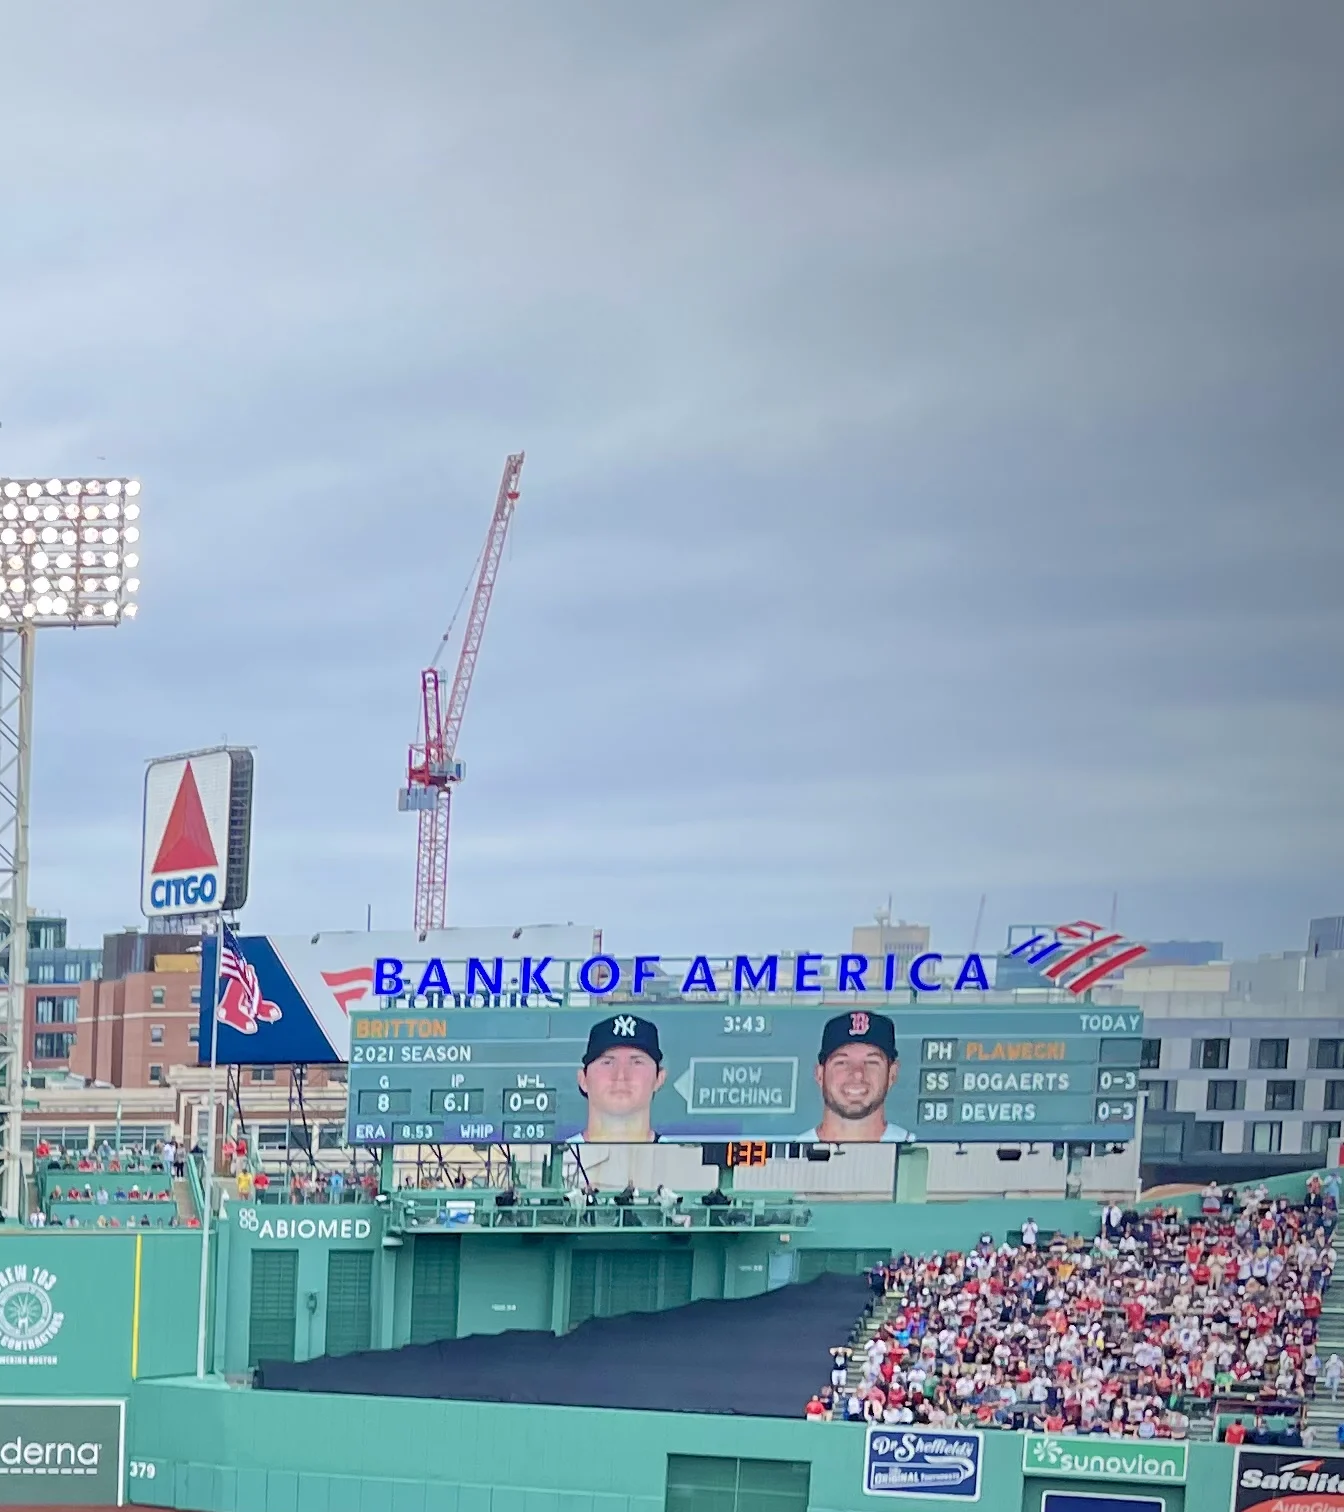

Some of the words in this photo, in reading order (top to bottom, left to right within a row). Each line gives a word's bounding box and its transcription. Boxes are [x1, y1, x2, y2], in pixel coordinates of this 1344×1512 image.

[151, 873, 217, 909] CITGO
[372, 956, 555, 998] BANK
[578, 954, 661, 996] OF
[681, 952, 990, 995] AMERICA
[356, 1019, 447, 1039] BRITTON
[723, 1016, 765, 1033] 3:43
[1080, 1015, 1141, 1031] TODAY
[353, 1046, 394, 1062] 2021
[401, 1046, 472, 1062] SEASON
[927, 1042, 952, 1060] PH
[966, 1042, 1066, 1060] PLAWECKI
[379, 1075, 389, 1088] G
[451, 1074, 465, 1088] IP
[517, 1074, 545, 1088] W-L
[722, 1067, 762, 1083] NOW
[926, 1072, 950, 1090] SS
[963, 1073, 1070, 1091] BOGAERTS
[1100, 1072, 1136, 1090] 0-3
[377, 1093, 390, 1112] 8
[443, 1093, 470, 1112] 6.1
[509, 1093, 548, 1111] 0-0
[699, 1088, 783, 1104] PITCHING
[923, 1103, 948, 1121] 3B
[962, 1103, 1037, 1121] DEVERS
[1098, 1102, 1134, 1120] 0-3
[356, 1124, 386, 1139] ERA
[402, 1125, 433, 1139] 8.53
[460, 1124, 494, 1139] WHIP
[512, 1125, 545, 1138] 2.05
[258, 1218, 371, 1239] ABIOMED
[32, 1266, 57, 1291] 103
[129, 1462, 155, 1479] 379
[1060, 1453, 1176, 1476] sunovion
